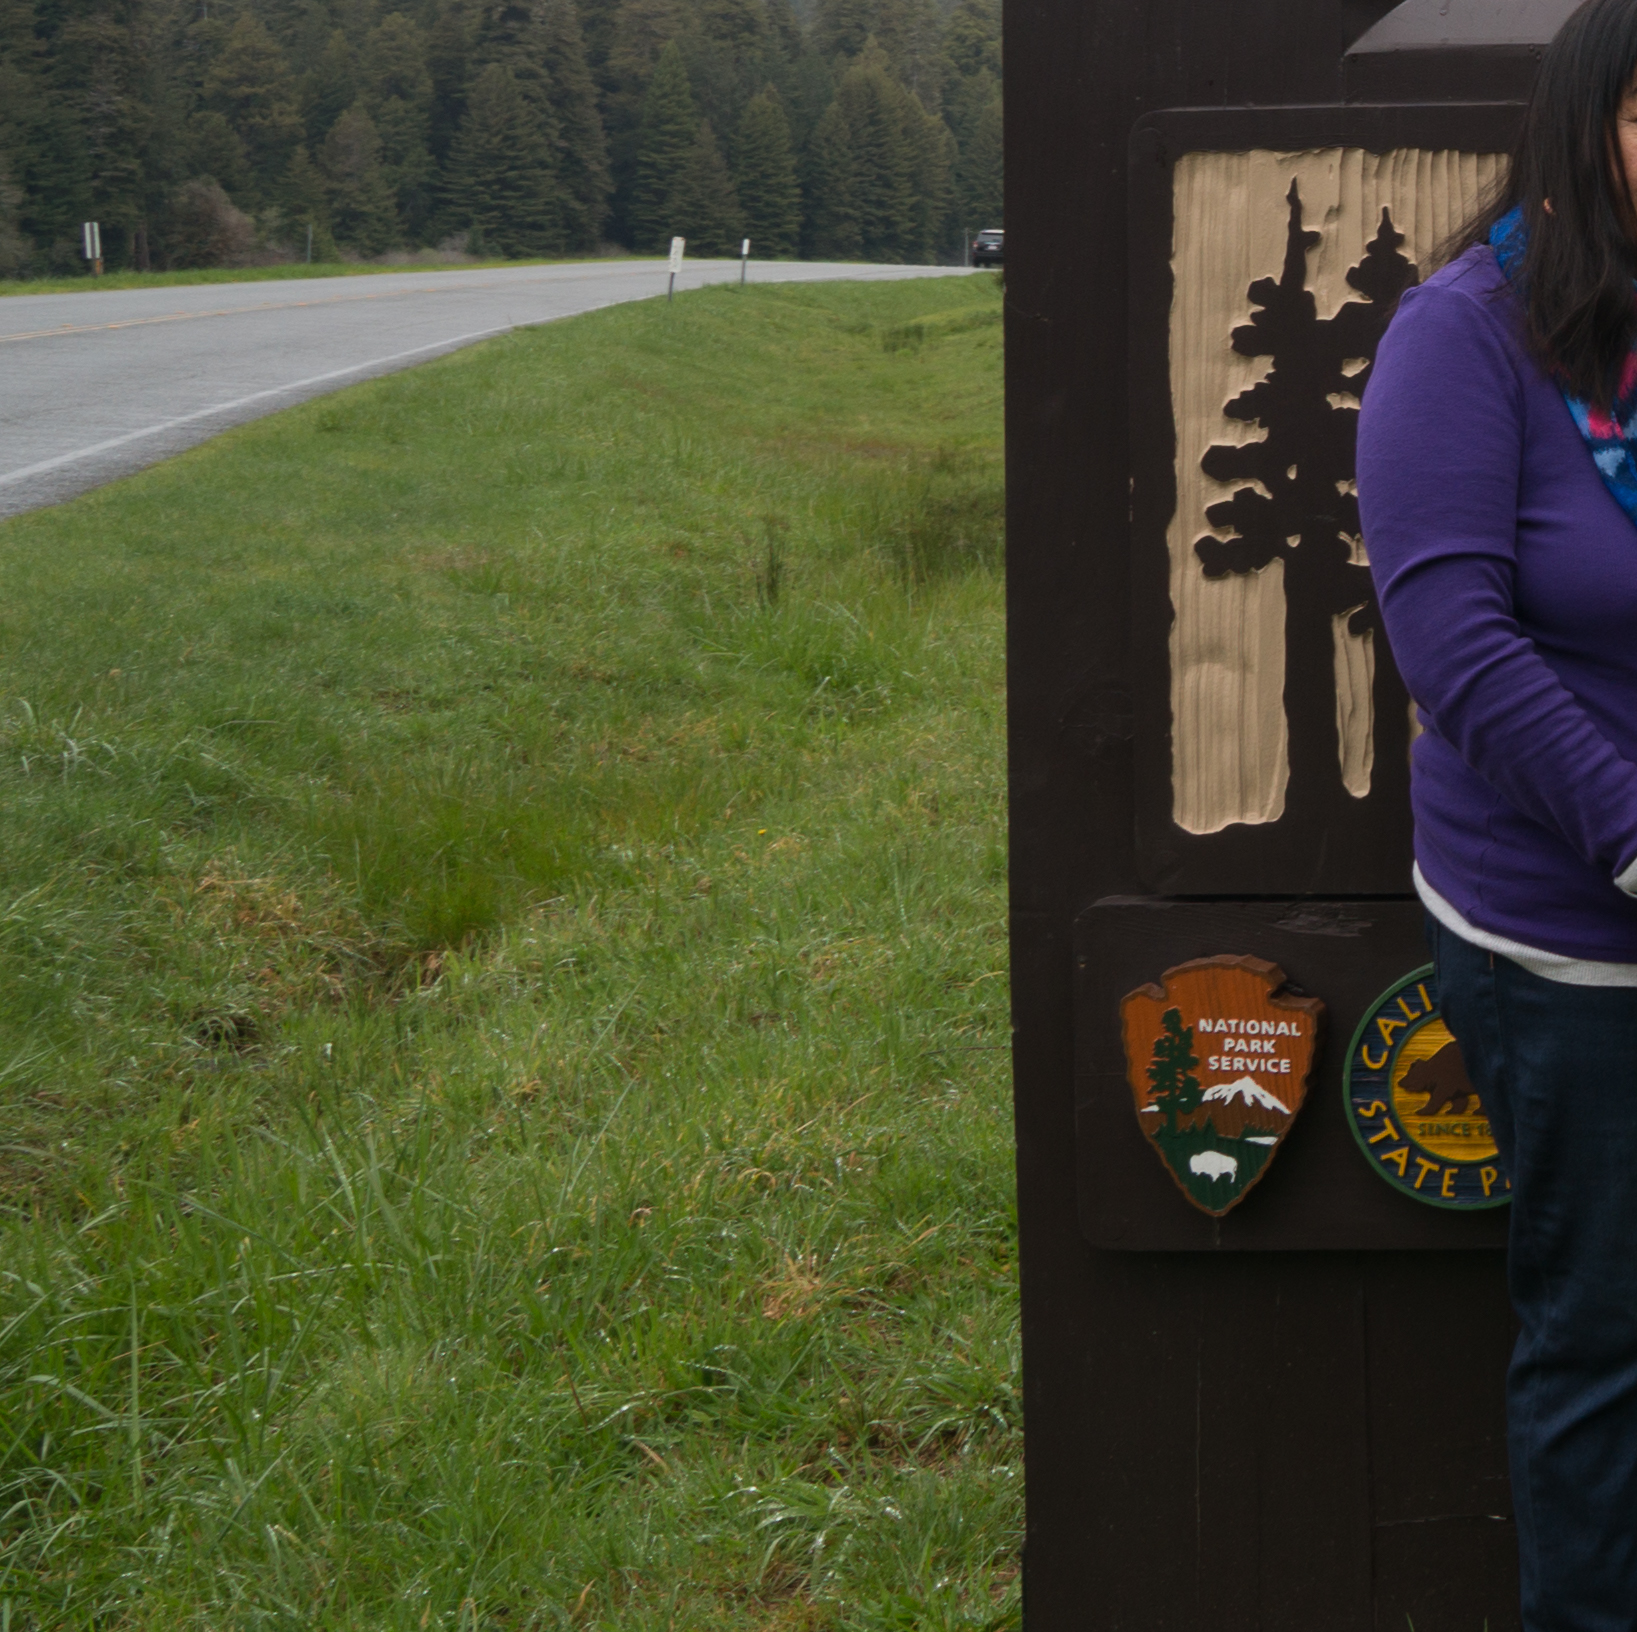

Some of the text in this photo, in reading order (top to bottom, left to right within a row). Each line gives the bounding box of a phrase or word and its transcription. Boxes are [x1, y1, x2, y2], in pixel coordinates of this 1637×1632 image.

[1199, 1018, 1302, 1037] NATIONAL
[1223, 1037, 1276, 1054] PARK
[1207, 1056, 1292, 1074] SERVICE
[1417, 1121, 1470, 1137] SINCE
[1358, 1100, 1459, 1198] STATE
